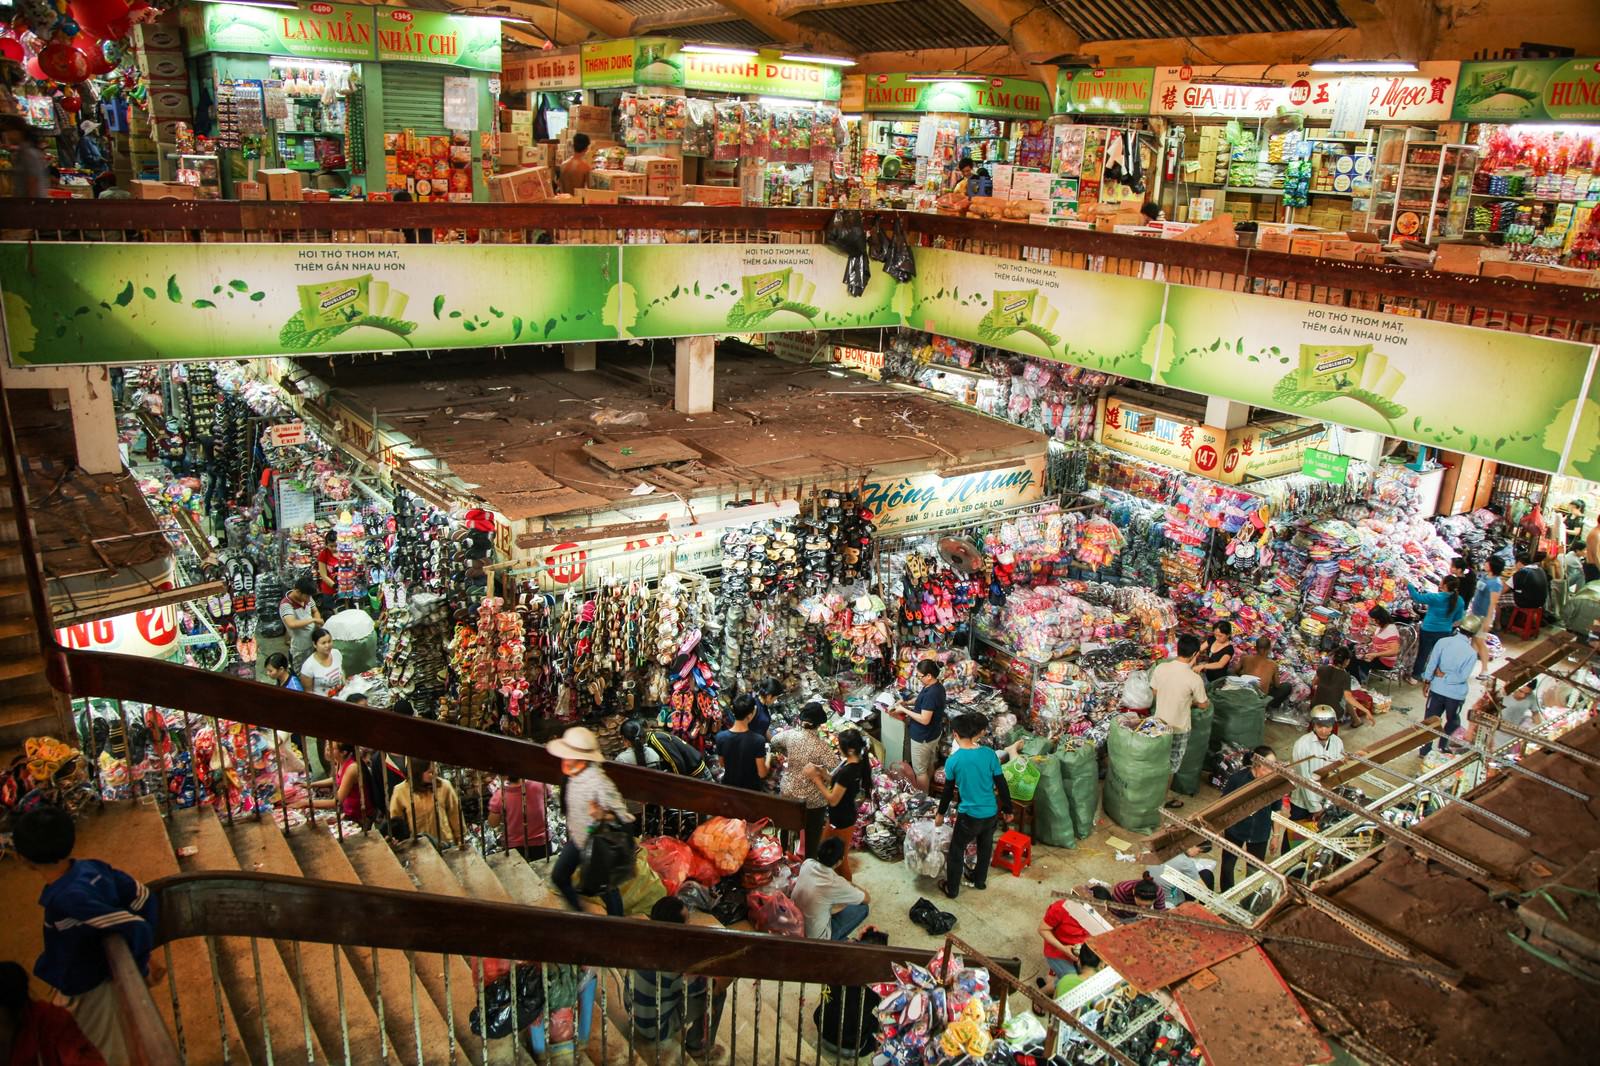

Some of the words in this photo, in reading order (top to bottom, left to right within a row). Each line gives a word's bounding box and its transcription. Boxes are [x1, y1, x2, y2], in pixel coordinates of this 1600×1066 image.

[283, 17, 323, 40] LAN
[1183, 87, 1215, 107] GIA
[1223, 88, 1252, 106] HY
[1312, 83, 1329, 104] 玉
[352, 263, 380, 271] NHAU
[1353, 329, 1382, 341] NHAU
[1196, 449, 1216, 468] 147
[1224, 452, 1239, 470] 147
[858, 478, 938, 515] Hồng
[942, 468, 1035, 503] Nhung
